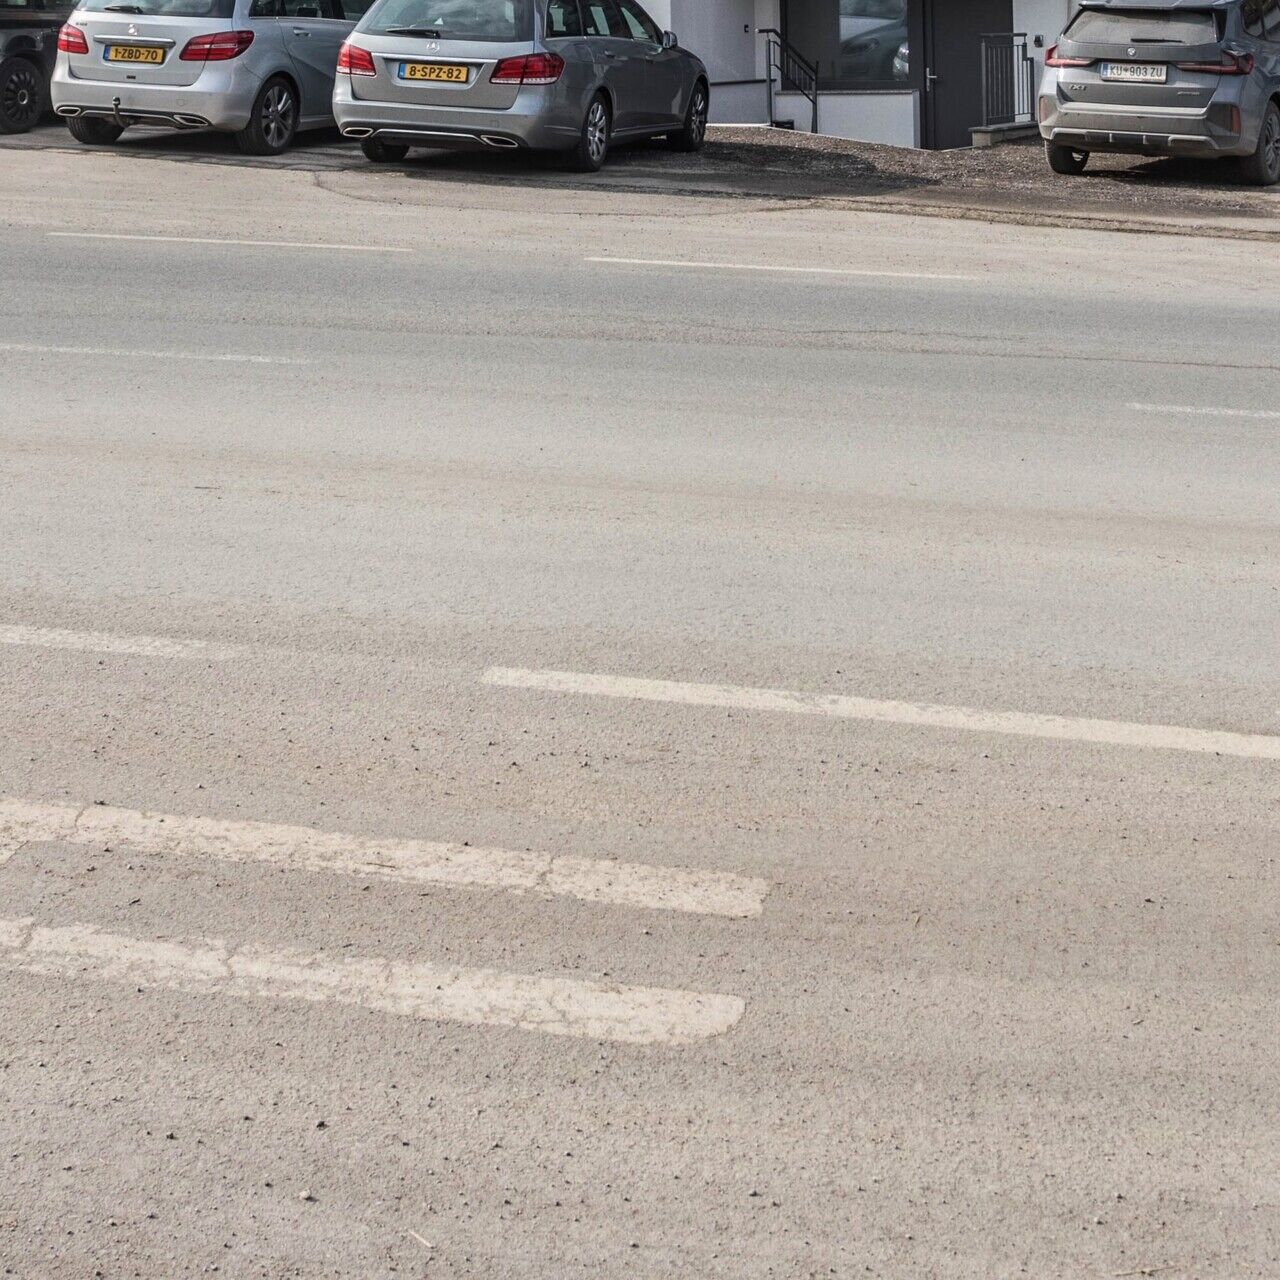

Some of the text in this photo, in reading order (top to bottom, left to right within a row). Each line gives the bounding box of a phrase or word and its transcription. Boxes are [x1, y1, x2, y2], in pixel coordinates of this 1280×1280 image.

[114, 47, 158, 61] 1-ZBD-70
[409, 65, 462, 80] 8-SPZ-82
[1129, 66, 1148, 77] 903
